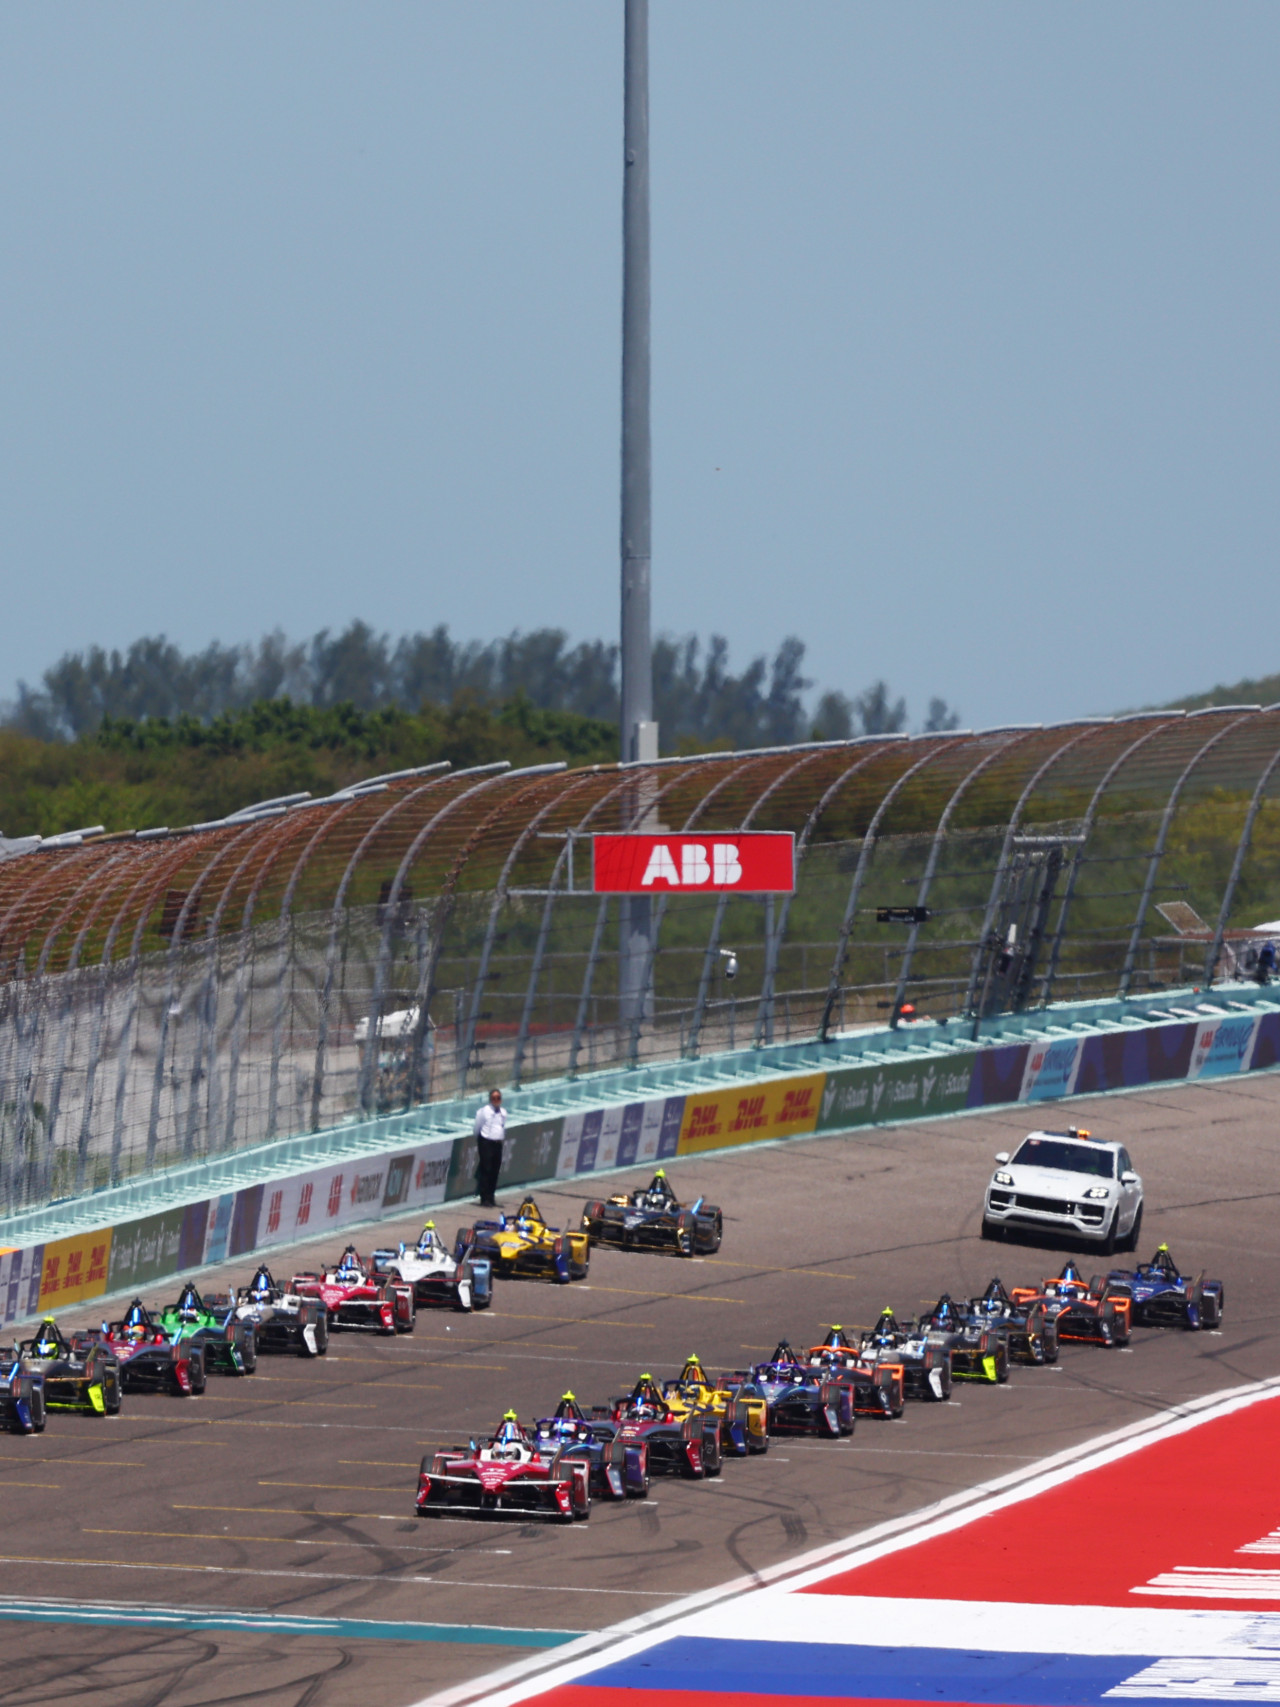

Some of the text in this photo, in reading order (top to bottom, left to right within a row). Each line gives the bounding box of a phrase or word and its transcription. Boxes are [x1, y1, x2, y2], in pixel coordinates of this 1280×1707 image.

[641, 843, 742, 885] ABB
[687, 1103, 719, 1138] DHL
[733, 1095, 766, 1131] DHL
[778, 1087, 814, 1123] DHL
[266, 1190, 283, 1234] ABB
[296, 1182, 313, 1226] ABB
[327, 1174, 343, 1217] ABB
